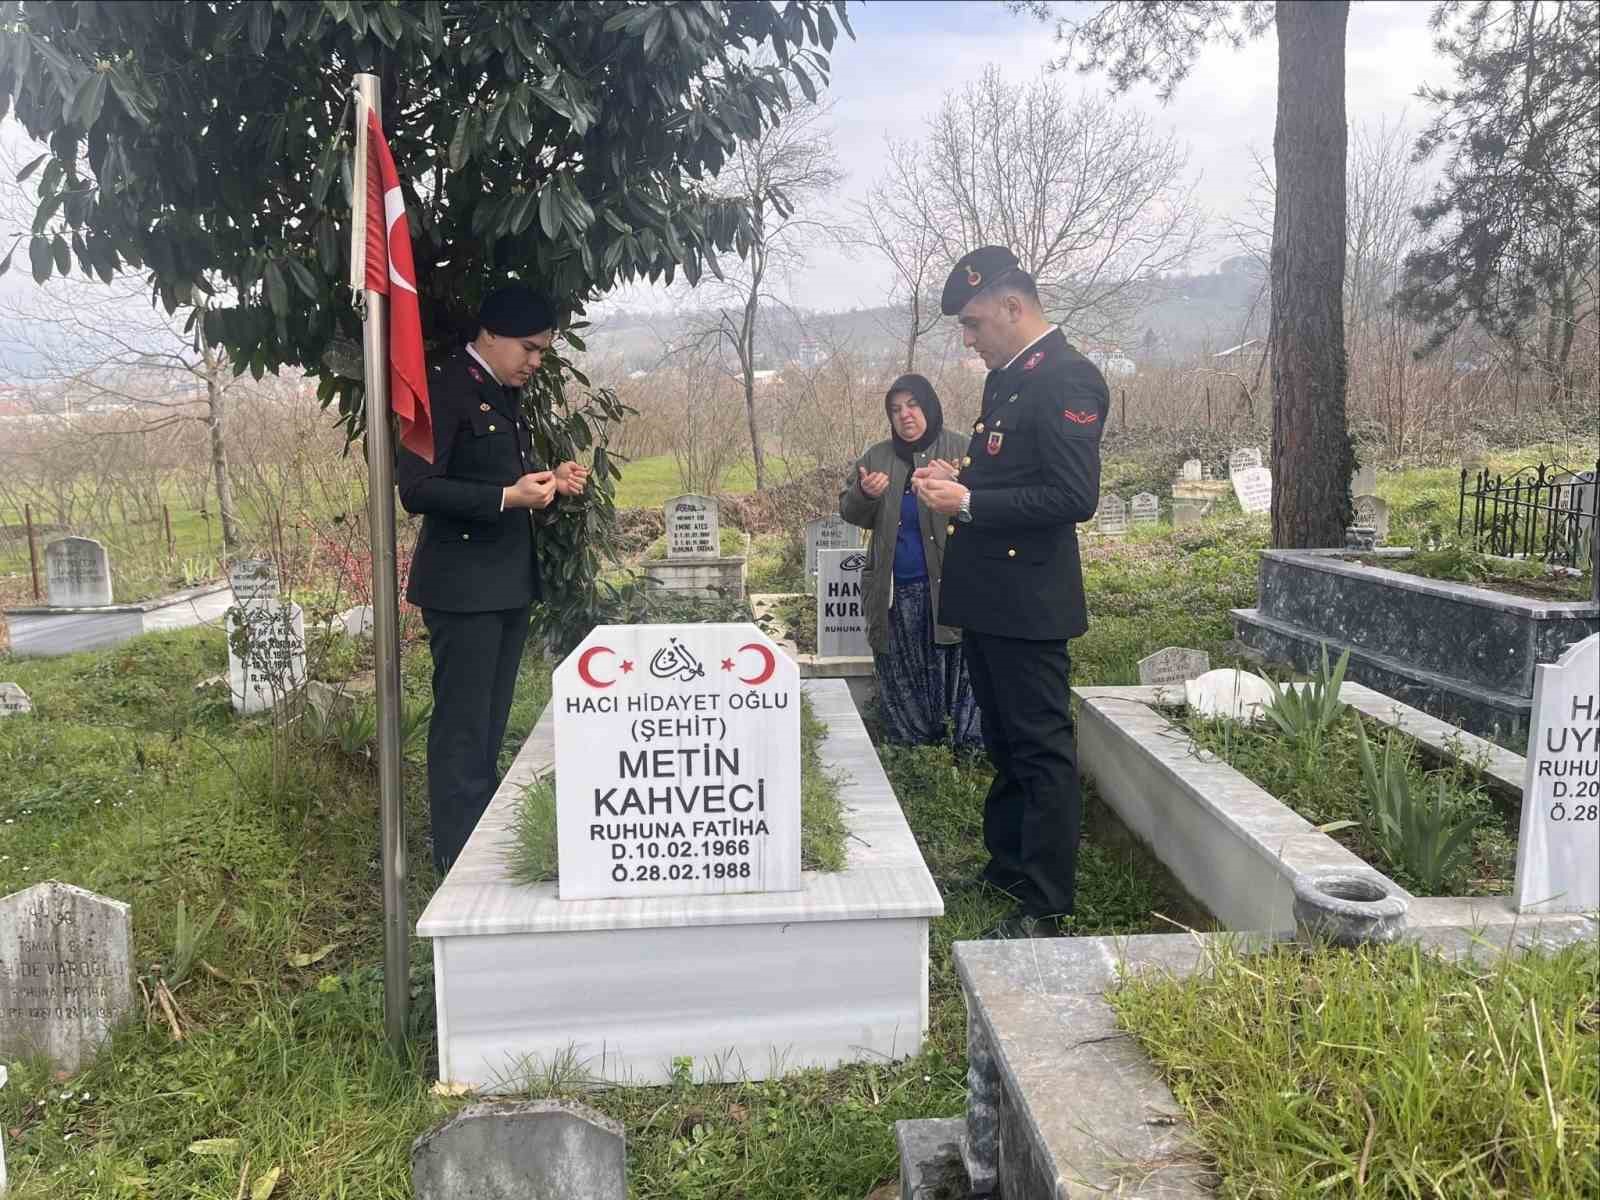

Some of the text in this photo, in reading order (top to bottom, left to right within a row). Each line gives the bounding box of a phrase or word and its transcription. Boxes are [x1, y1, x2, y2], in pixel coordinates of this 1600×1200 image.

[567, 690, 788, 713] HACI HİDAYET OĞLU
[1571, 694, 1600, 721] H
[631, 715, 727, 742] (ŞEHİT)
[619, 743, 740, 778] METİN
[594, 778, 765, 817] KAHVECİ
[1550, 803, 1598, 822] Ö.28
[590, 817, 769, 841] RUHUNA FATİHA
[611, 839, 750, 860] D.10.02.1966
[611, 862, 751, 883] Ö.28.02.1988
